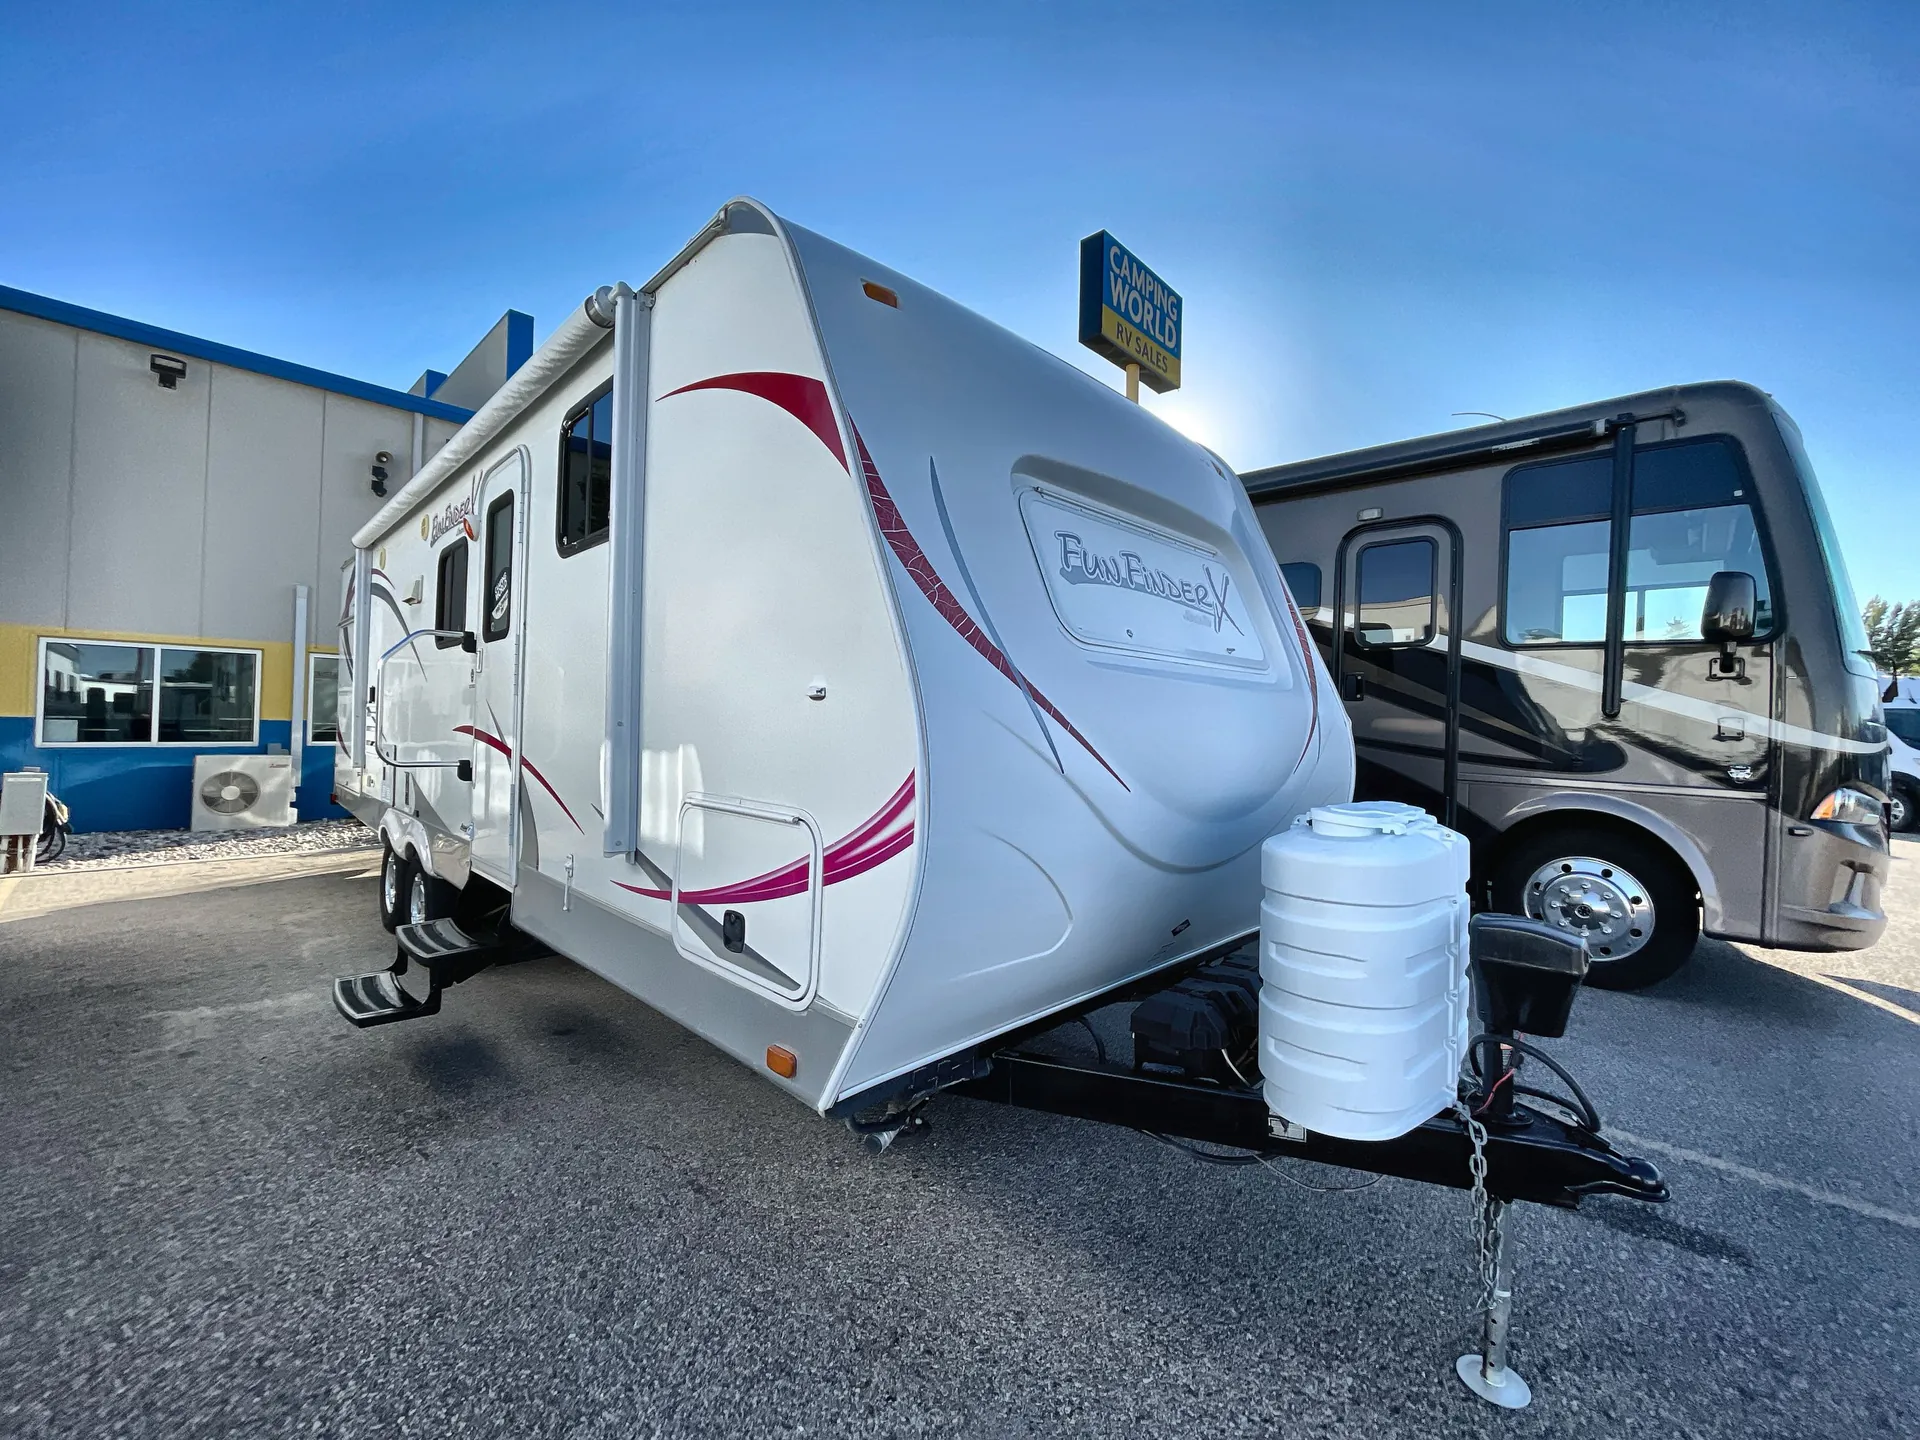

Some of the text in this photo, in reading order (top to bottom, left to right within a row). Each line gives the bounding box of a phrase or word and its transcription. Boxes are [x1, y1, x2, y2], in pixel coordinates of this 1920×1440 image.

[1109, 245, 1177, 322] CAMPING
[1109, 270, 1177, 349] WORLD
[1116, 321, 1168, 373] RV SALES
